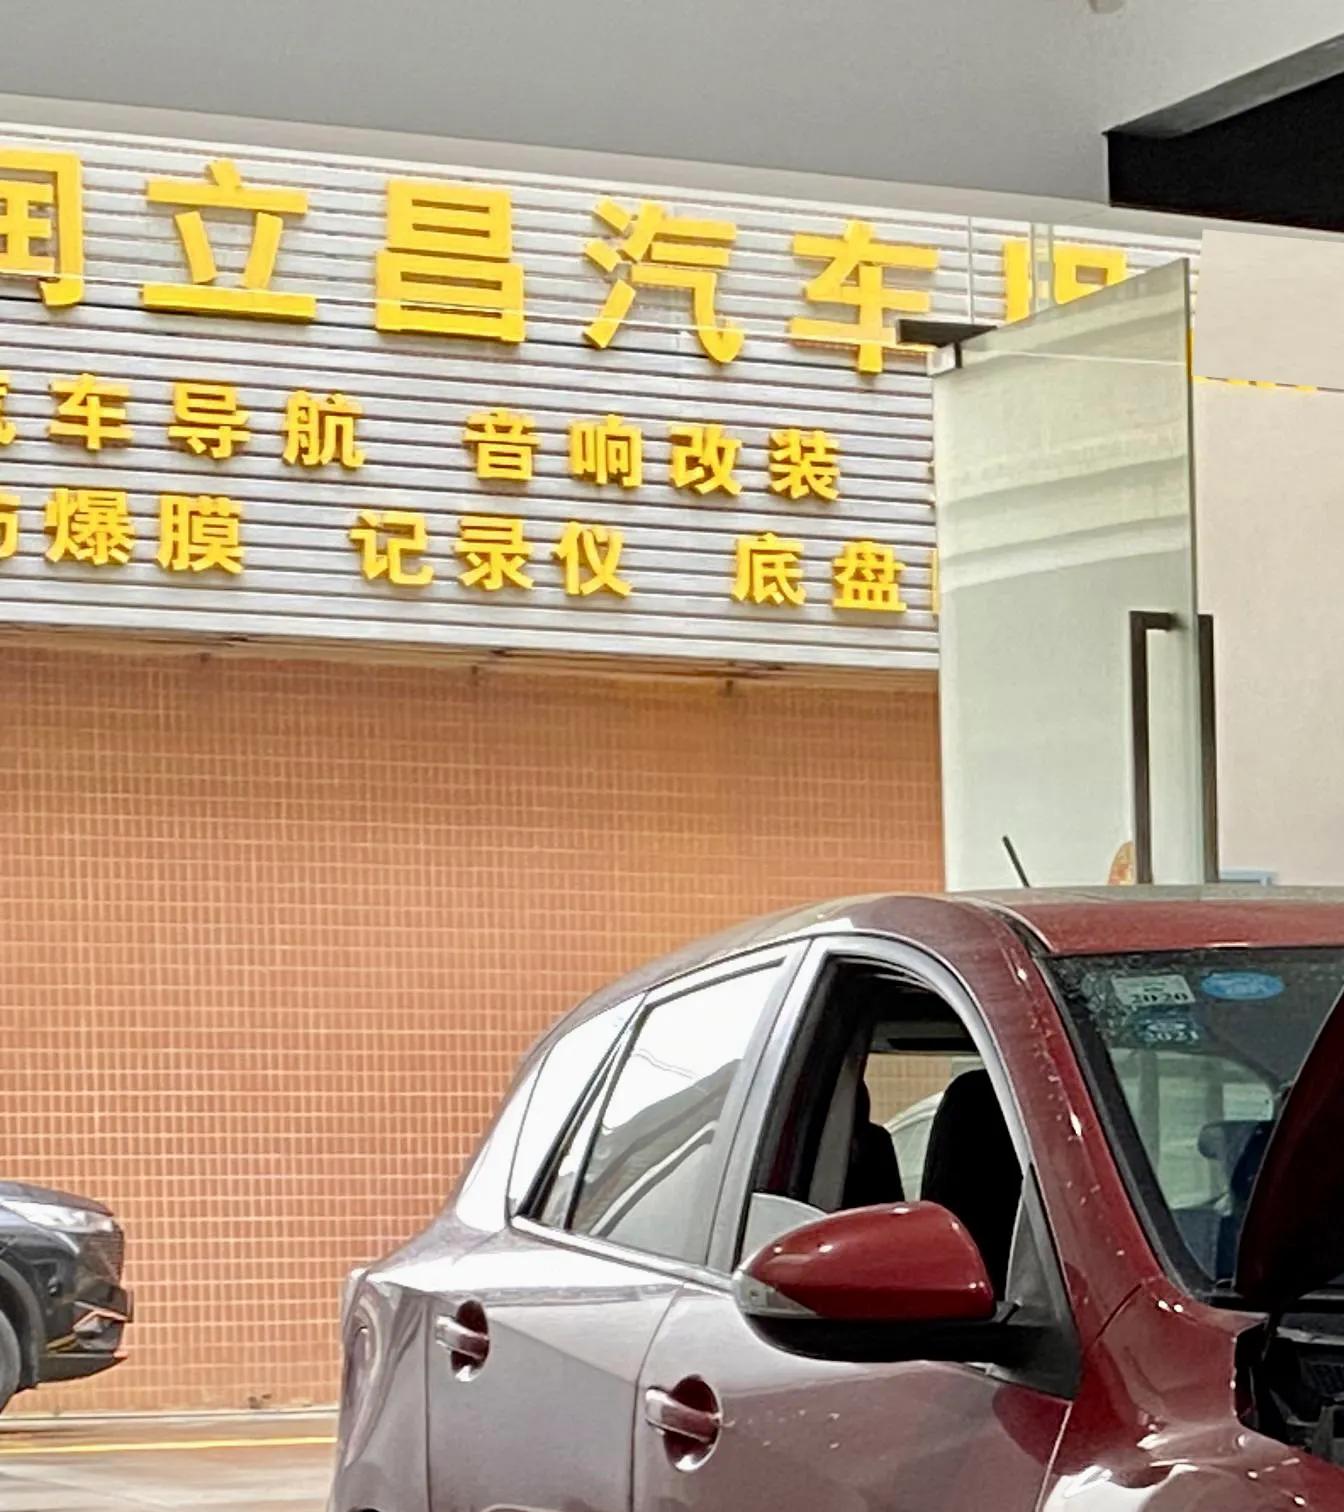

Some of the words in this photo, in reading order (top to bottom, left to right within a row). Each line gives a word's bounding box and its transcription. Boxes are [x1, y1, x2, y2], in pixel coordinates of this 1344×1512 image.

[0, 371, 365, 469] 车导航
[462, 407, 840, 501] 音响改装
[350, 509, 632, 597] 记录仪
[732, 532, 939, 616] 底盘
